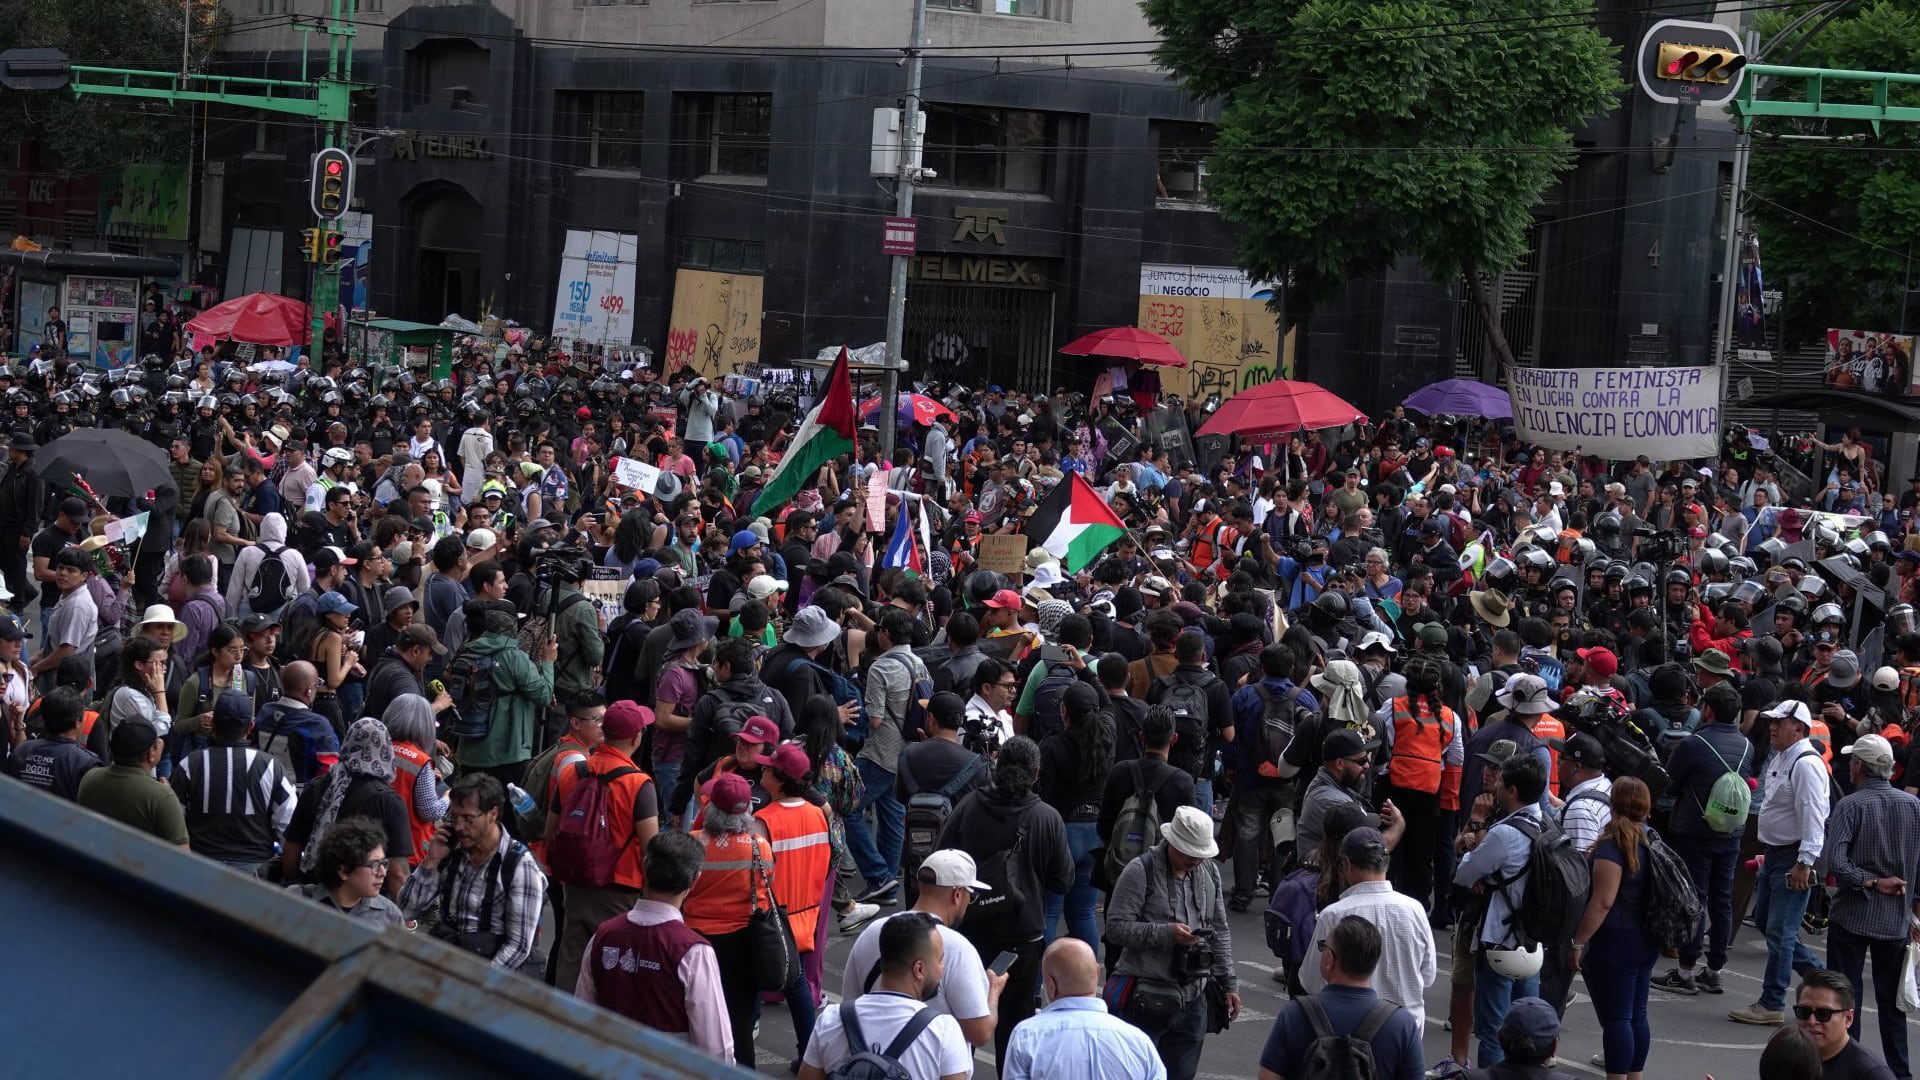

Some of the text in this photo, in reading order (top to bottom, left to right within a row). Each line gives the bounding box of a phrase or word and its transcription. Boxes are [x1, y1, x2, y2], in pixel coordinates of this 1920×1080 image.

[1679, 84, 1701, 96] CDMX
[416, 135, 488, 160] TELMEX
[29, 179, 57, 202] KFC
[1647, 238, 1661, 268] 4
[908, 256, 1032, 285] TELMEX
[1147, 271, 1187, 281] JUNTOS
[569, 280, 592, 302] 150
[1147, 285, 1210, 296] TU NEGOCIO
[1594, 368, 1701, 390] FEMINISTA
[1516, 385, 1681, 409] EN LUCHA CONTRA LA
[1516, 404, 1718, 438] VIOLENCIA ECONOMICA
[435, 681, 444, 692] 6
[25, 763, 50, 775] DGDH
[639, 959, 661, 971] SECGOB
